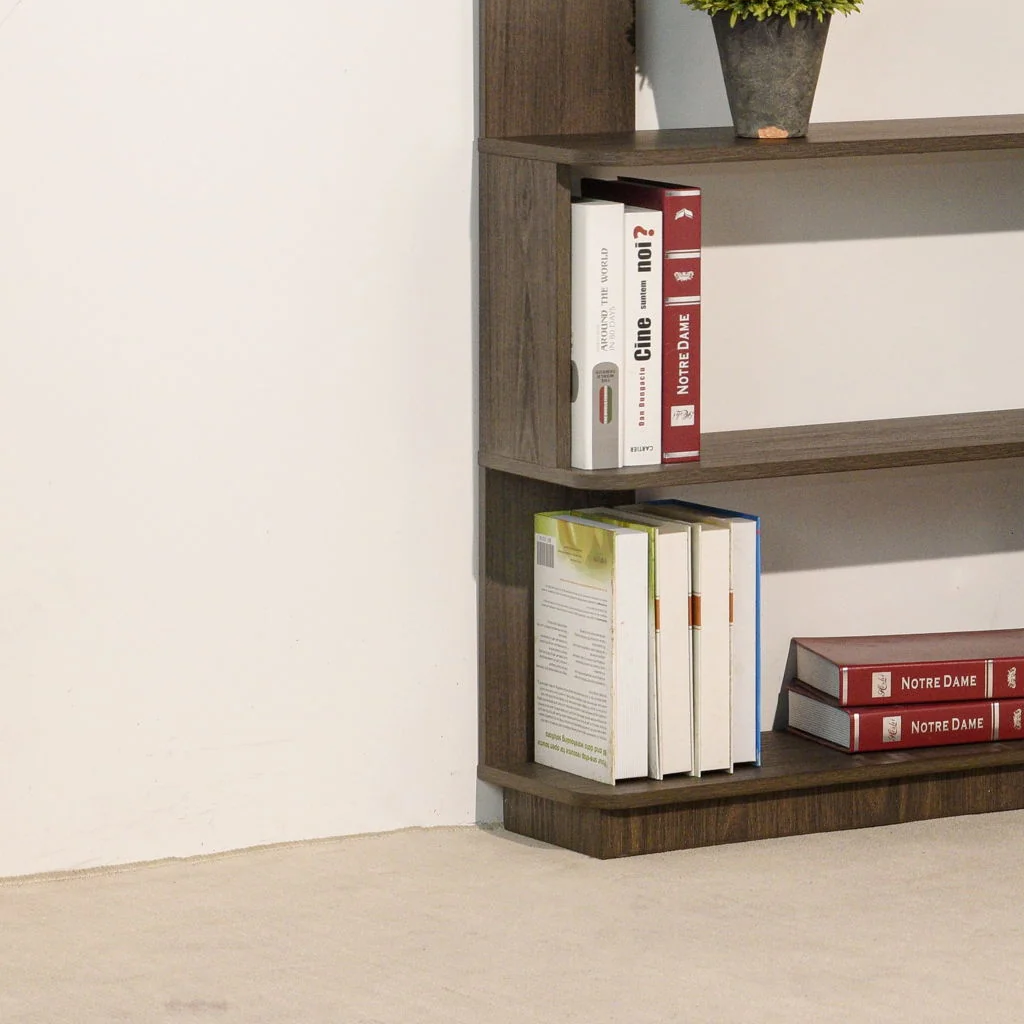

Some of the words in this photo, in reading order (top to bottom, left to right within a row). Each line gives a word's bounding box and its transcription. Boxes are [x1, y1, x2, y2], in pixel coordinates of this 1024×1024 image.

[600, 247, 608, 283] WORLD
[600, 287, 608, 306] THE
[639, 280, 647, 310] suntem
[600, 310, 608, 351] AROUND
[634, 317, 652, 362] Cine
[677, 313, 690, 350] DAME
[676, 351, 690, 395] NOTRE
[630, 445, 654, 453] CARTIER
[901, 675, 941, 690] NOTRE
[943, 674, 977, 688] DAME
[910, 719, 950, 734] NOTRE
[951, 717, 984, 731] DAME
